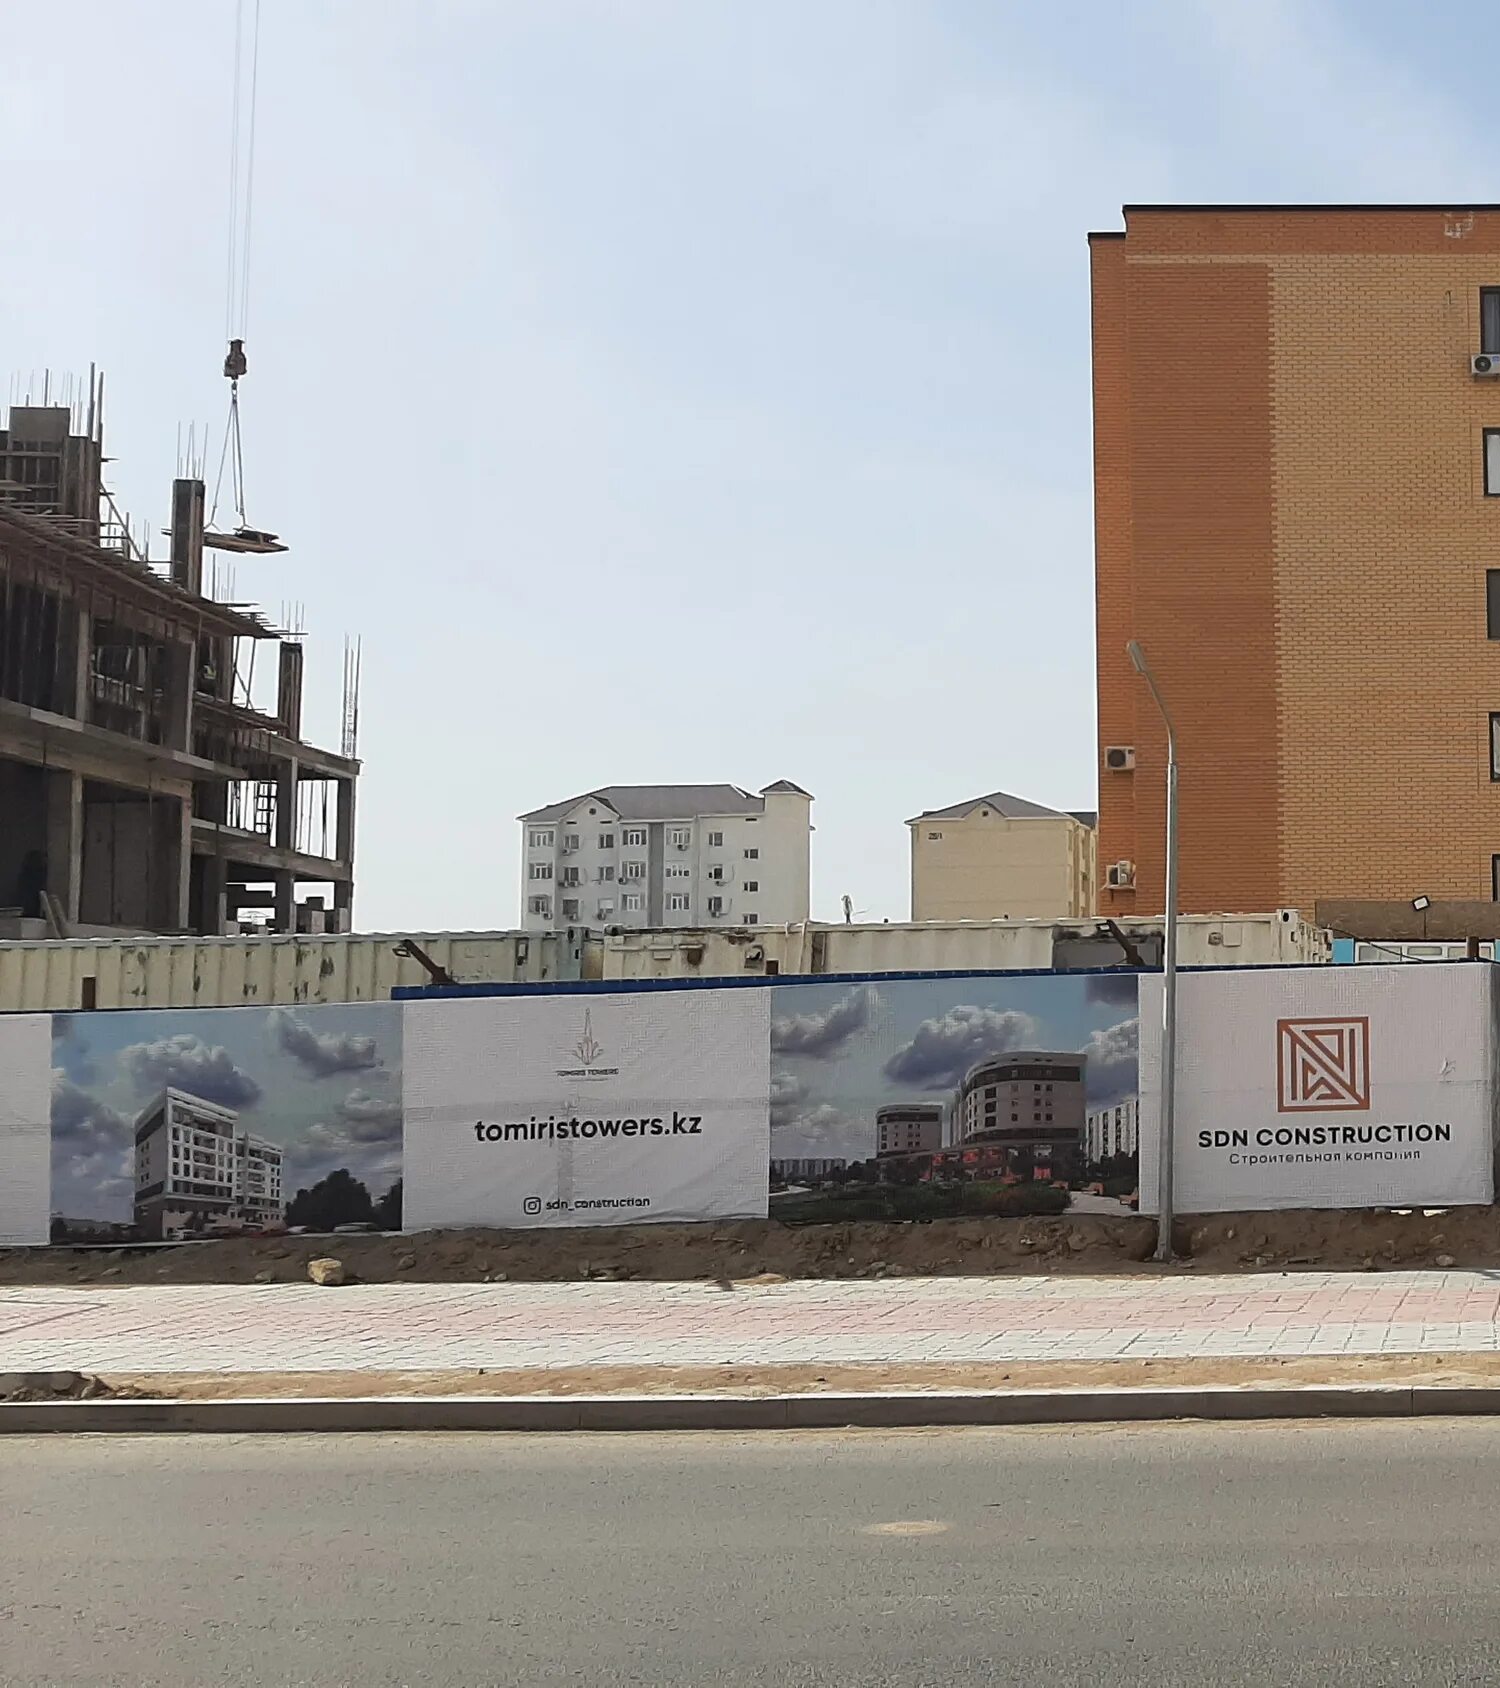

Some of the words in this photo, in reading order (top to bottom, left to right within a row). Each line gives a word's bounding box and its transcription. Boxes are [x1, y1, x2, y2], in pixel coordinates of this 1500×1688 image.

[474, 1111, 703, 1142] tomiristowers.kz
[1198, 1129, 1249, 1148] SDN
[1255, 1123, 1451, 1147] CONSTRUCTION
[1229, 1152, 1341, 1166] Строительная
[1345, 1150, 1421, 1161] компания
[545, 1197, 651, 1212] sdn_construction
